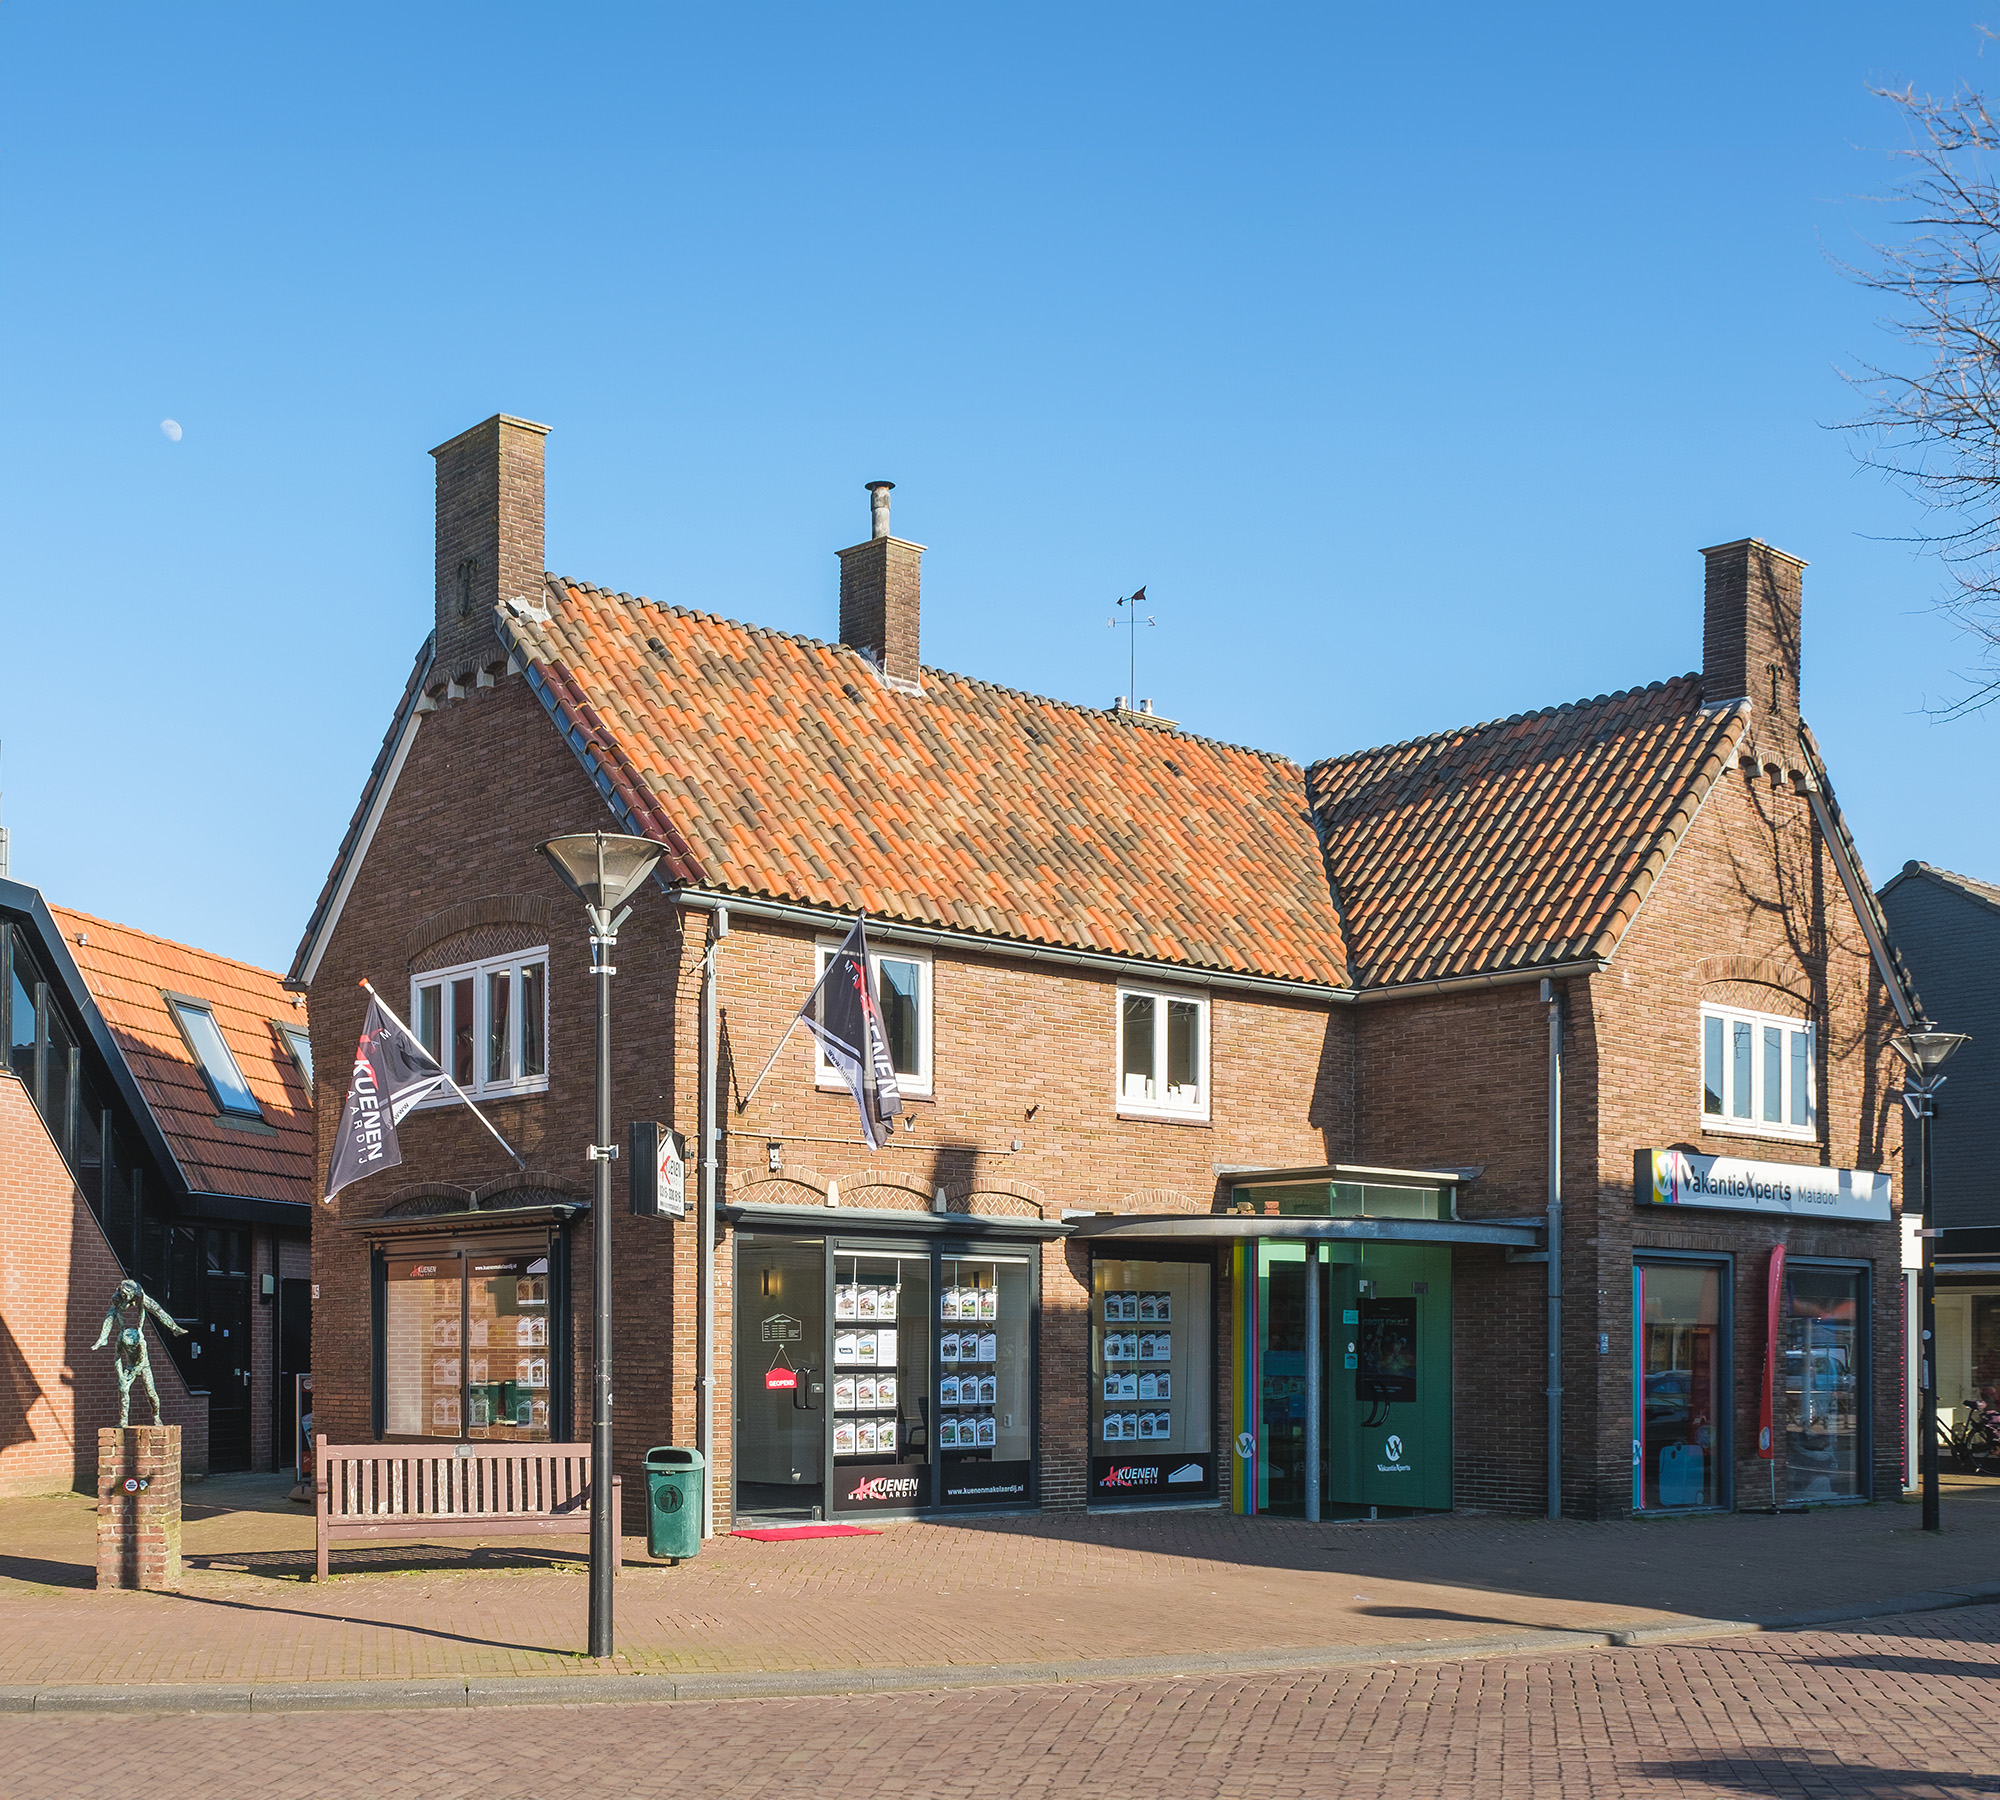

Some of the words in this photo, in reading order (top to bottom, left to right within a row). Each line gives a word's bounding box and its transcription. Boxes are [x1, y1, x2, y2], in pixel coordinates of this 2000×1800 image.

[353, 1059, 383, 1161] KUENEN
[1681, 1164, 1792, 1204] VakantieXperts
[1798, 1186, 1840, 1206] Matador
[768, 1379, 795, 1387] GEOPEND
[1117, 1467, 1159, 1480] KUENEN
[869, 1478, 919, 1492] KUENEN
[947, 1484, 1024, 1495] www.kuenenmakelaardij.nl
[848, 1490, 919, 1500] MAKELAARDIJ
